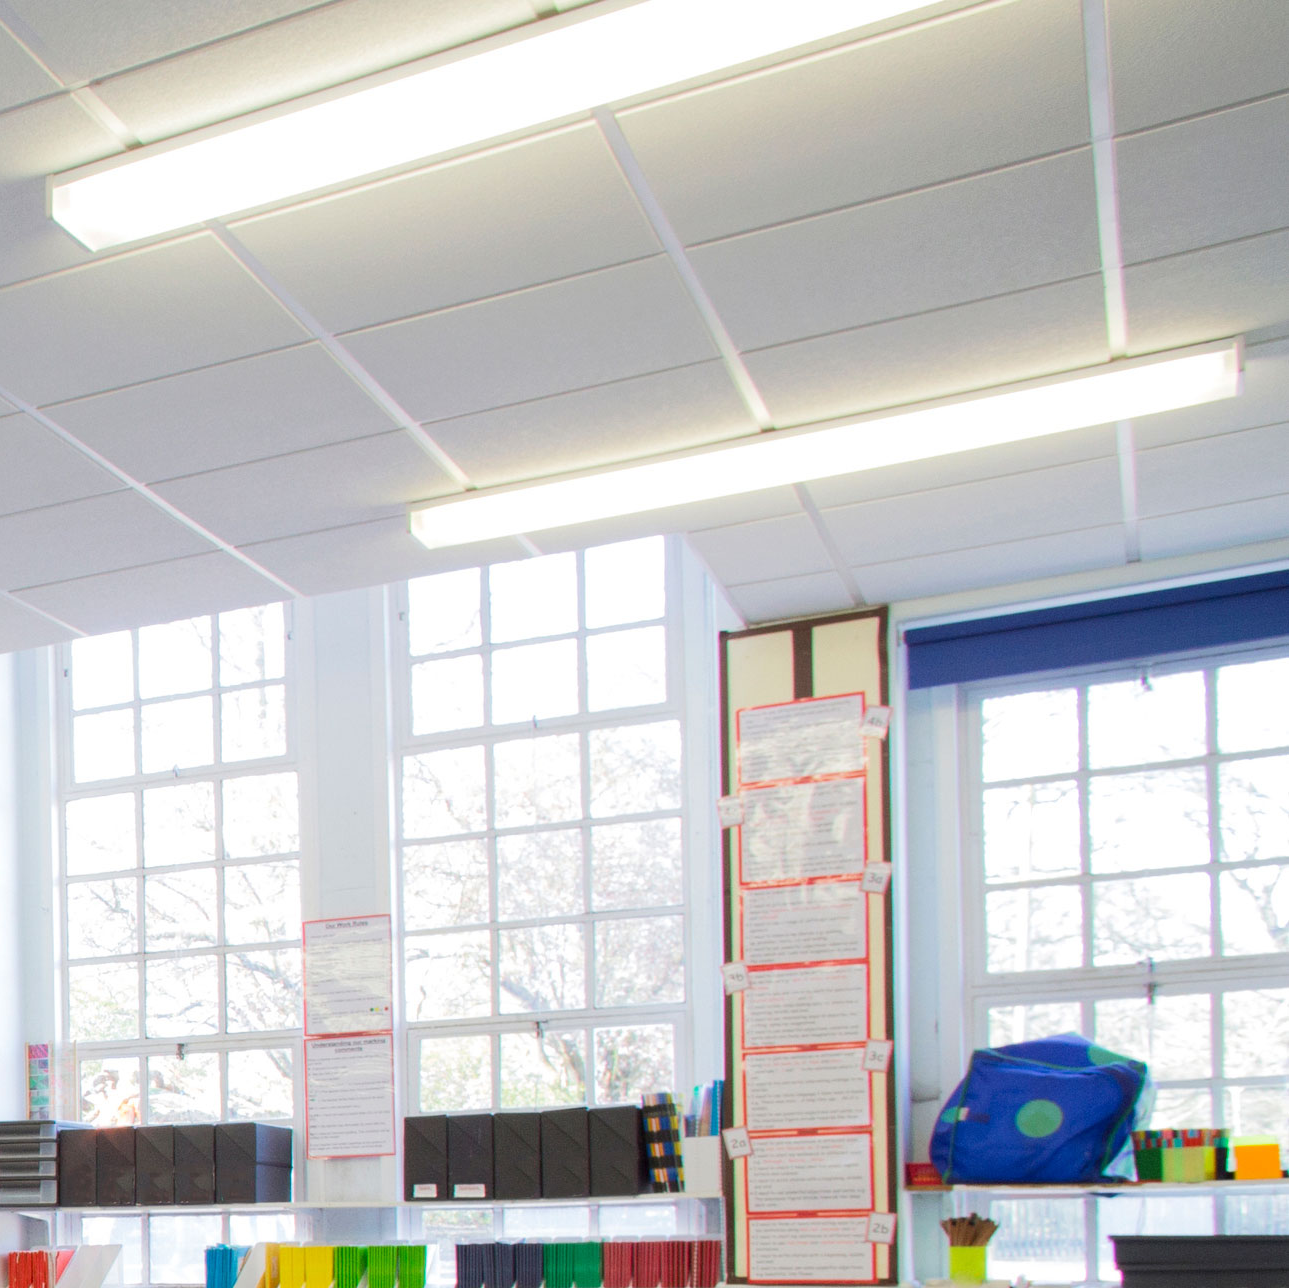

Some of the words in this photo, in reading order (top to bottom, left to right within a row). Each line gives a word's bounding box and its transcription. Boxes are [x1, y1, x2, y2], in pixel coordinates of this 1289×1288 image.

[868, 1050, 884, 1062] 3c
[731, 1139, 747, 1149] 2a
[873, 1223, 889, 1234] 2b
